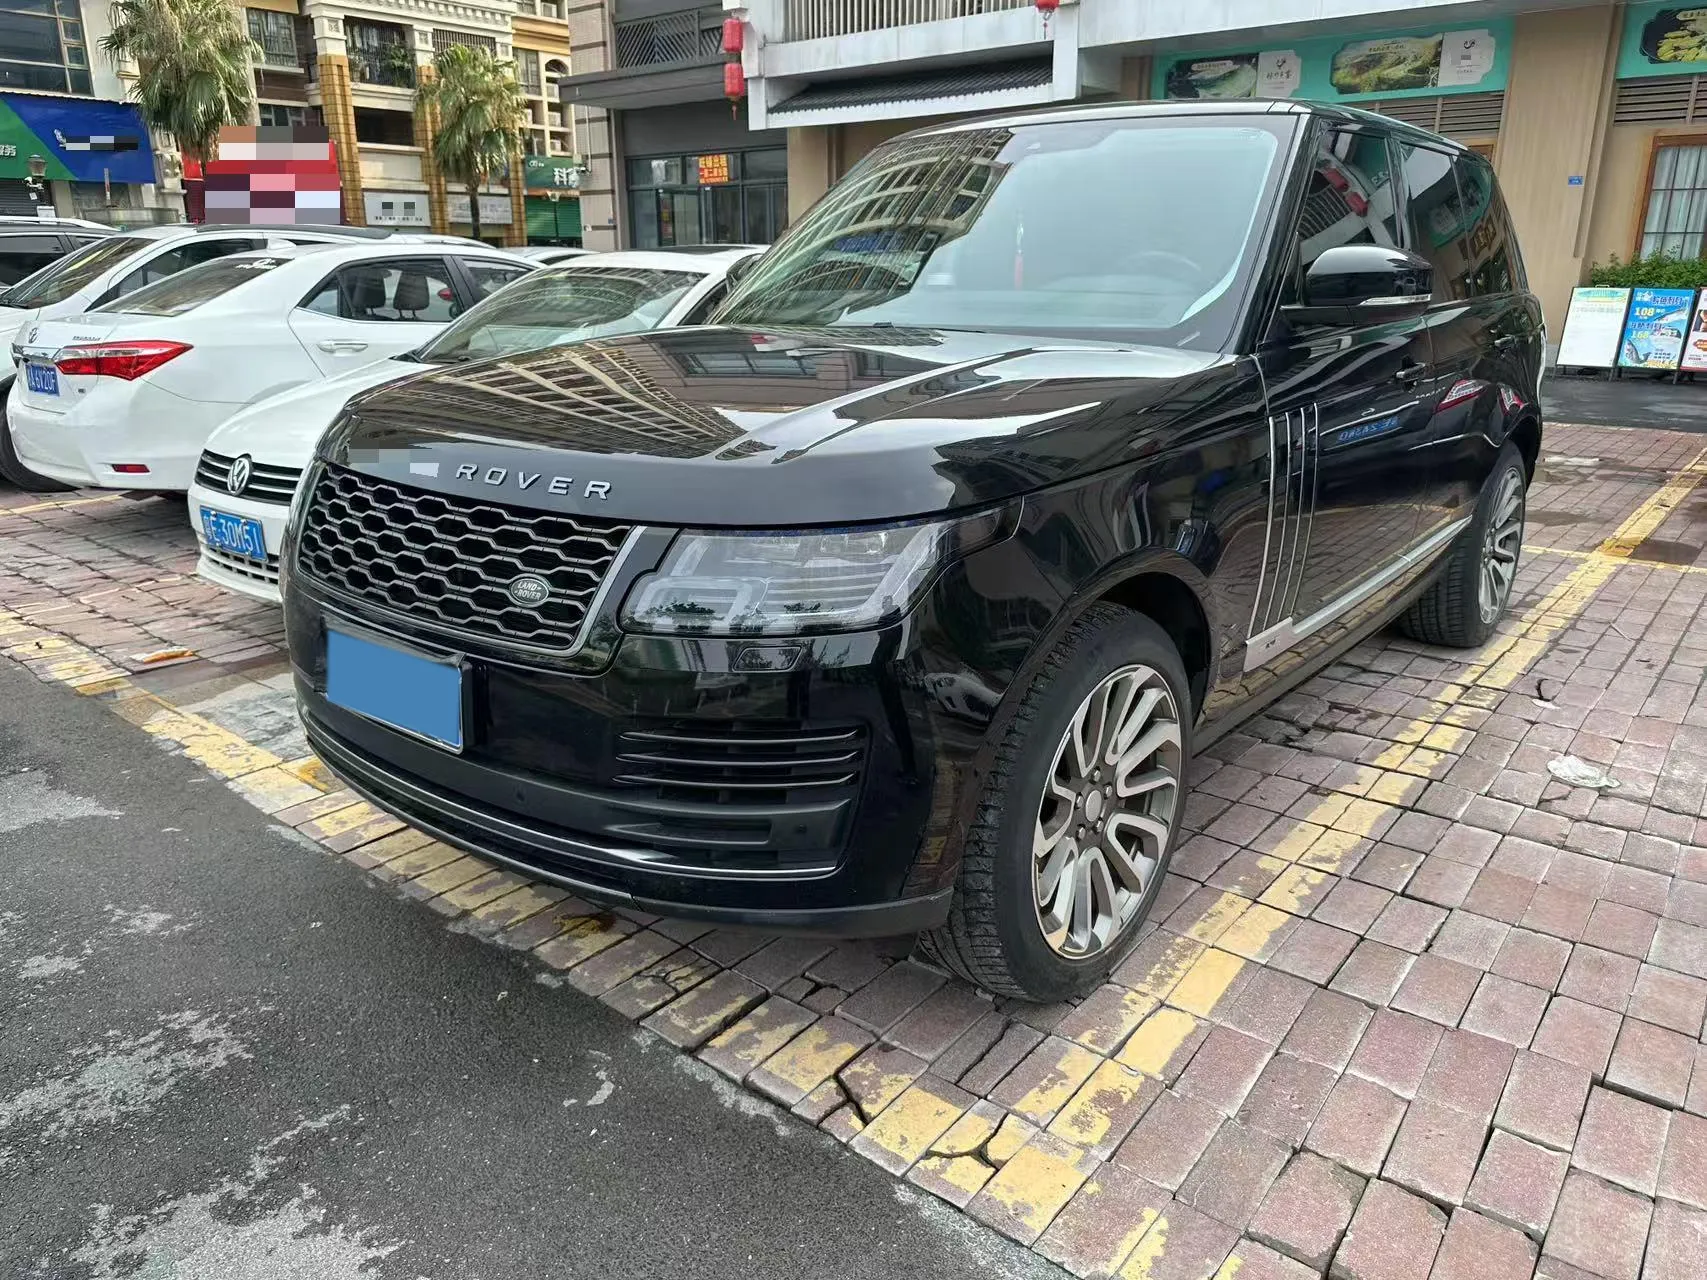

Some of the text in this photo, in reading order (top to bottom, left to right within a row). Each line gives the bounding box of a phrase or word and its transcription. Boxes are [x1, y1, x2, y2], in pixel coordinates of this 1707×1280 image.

[455, 463, 612, 500] ROVER
[517, 581, 538, 591] LAND
[517, 588, 542, 601] ROVER
